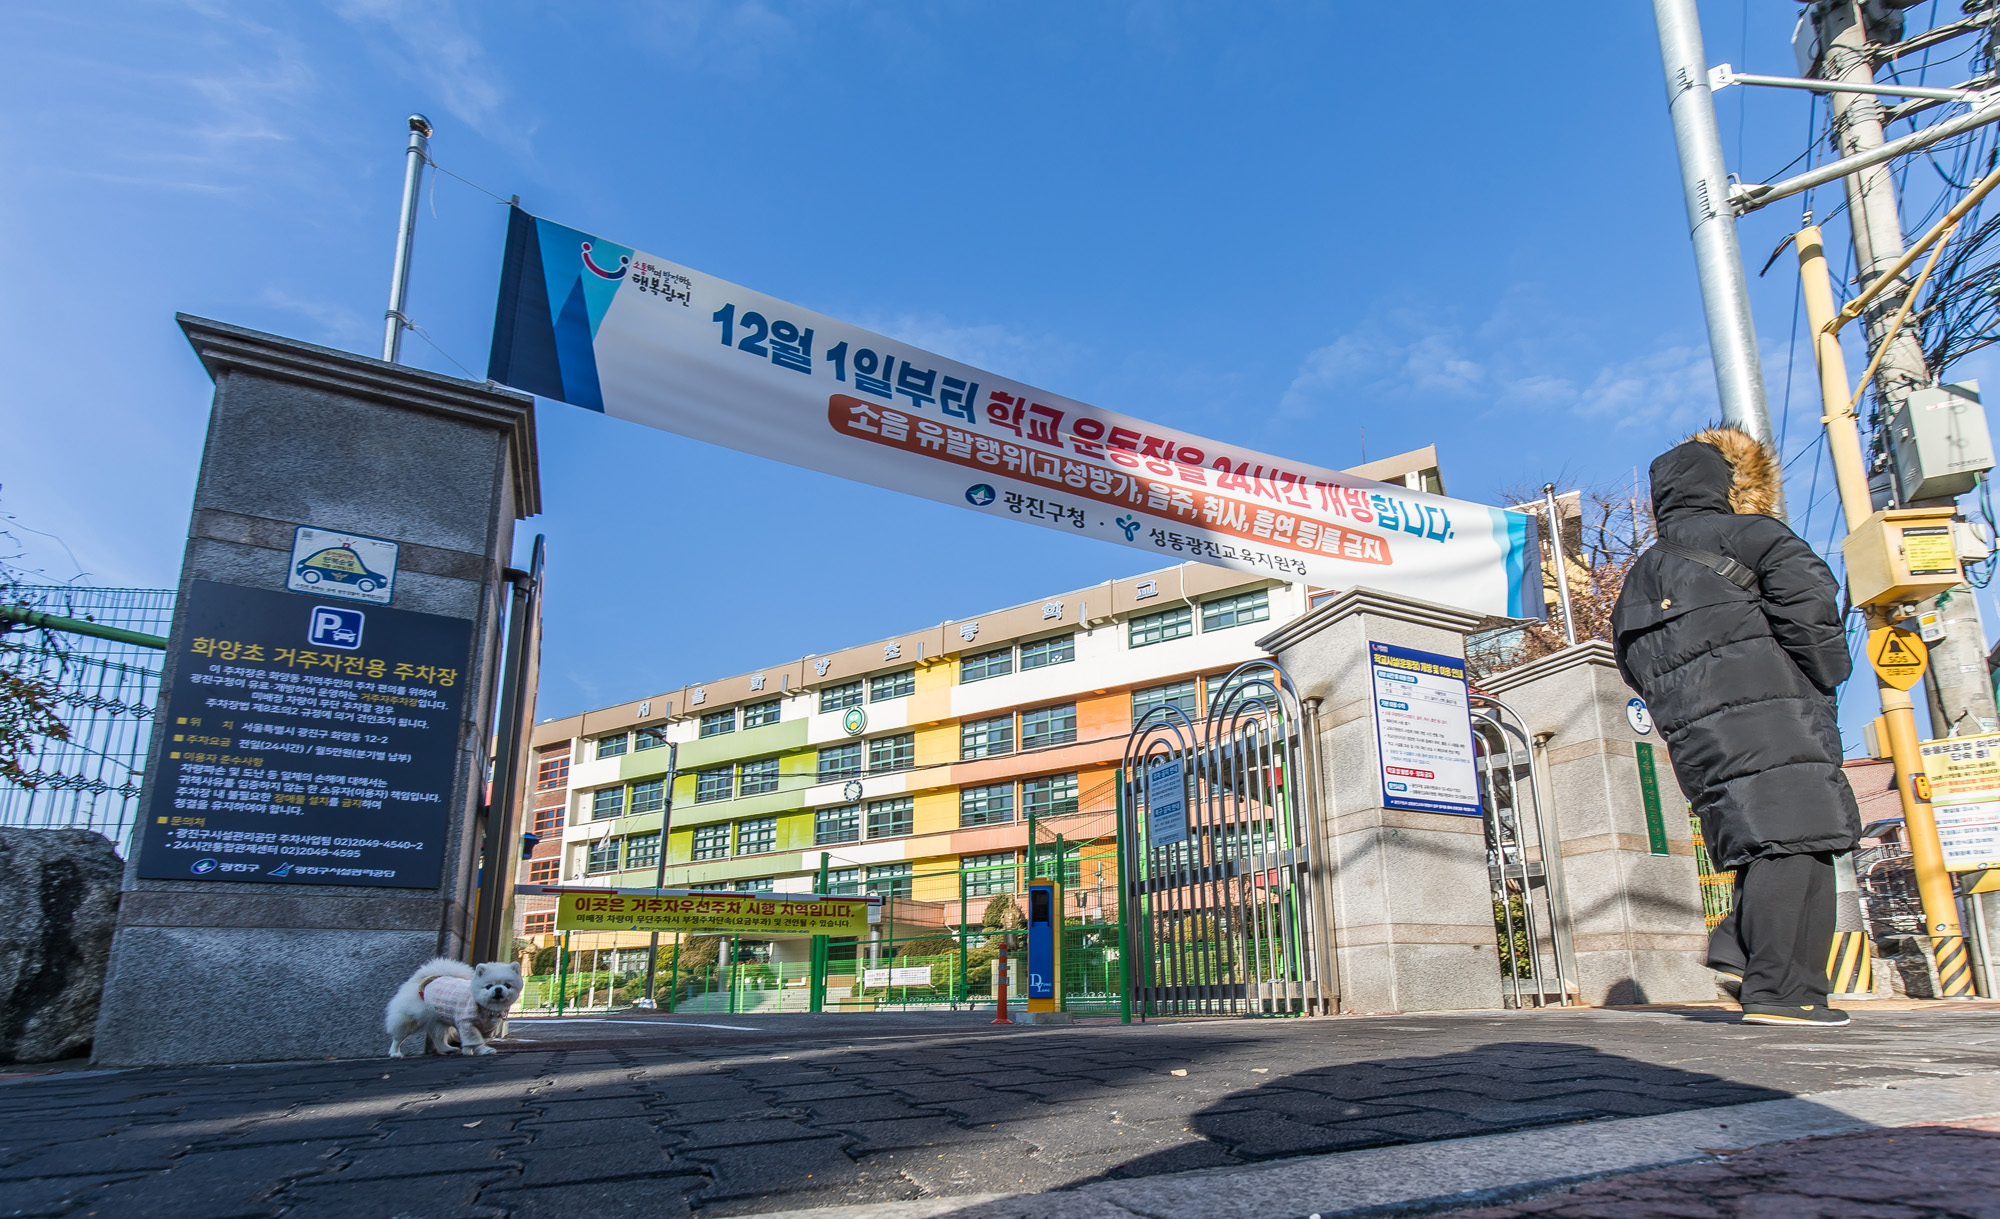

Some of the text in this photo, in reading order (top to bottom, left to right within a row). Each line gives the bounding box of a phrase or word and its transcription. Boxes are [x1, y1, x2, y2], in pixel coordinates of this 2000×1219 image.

[632, 273, 691, 307] 행복광진
[713, 303, 1456, 543] 12월 1일부터 학교 운동장을 24시간 개방합니다.
[847, 402, 1384, 562] 소음 유발행위(고성방가, 음주, 취사, 흡연 등)를 금지
[1003, 491, 1307, 575] 광진구청 성동광진교육지원청
[315, 612, 342, 639] P
[190, 636, 458, 687] 화양초 거주자전용 주차장
[1888, 655, 1909, 663] SOS
[190, 673, 246, 688] 광진구청이
[318, 687, 358, 700] 운영하는
[361, 693, 448, 710] 거주자주차장입니다.
[209, 664, 437, 698] 이 주차장은 화양동 지역주민의 주차 편의를 위하여
[205, 698, 250, 711] 주차장법
[300, 708, 333, 719] 규정에
[334, 711, 355, 722] 의거
[356, 713, 396, 726] 견인조치
[251, 692, 394, 715] 미배정 차량이 무단 주차할 경우
[1636, 712, 1643, 723] 9
[186, 734, 232, 747] 주차요금
[241, 722, 295, 736] 서울특별시
[297, 727, 329, 739] 광진구
[330, 731, 361, 742] 화양동
[364, 735, 389, 744] 12-2
[183, 751, 264, 767] 이용자 준수사항
[1950, 752, 1973, 761] 단속
[228, 766, 241, 777] 및
[241, 768, 265, 778] 도난
[267, 770, 279, 780] 등
[314, 773, 346, 785] 손해에
[347, 776, 388, 788] 대해서는
[175, 786, 212, 798] 주차장
[213, 789, 226, 799] 내
[227, 790, 272, 802] 불필요한
[390, 790, 442, 803] 책임입니다.
[269, 803, 304, 816] 합니다.
[170, 816, 206, 827] 문의처
[175, 828, 277, 843] 광진구시설관리공단
[218, 862, 260, 873] 광진구
[575, 897, 856, 918] 이곳은 거주자우선주차 시행 지역입니다.
[576, 914, 604, 923] 미배정
[606, 914, 634, 924] 차량이
[636, 915, 680, 924] 무단주차시
[682, 916, 771, 926] 부정주차단속(요금부과)
[774, 918, 782, 927] 및
[809, 919, 817, 928] 수
[819, 919, 852, 928] 있습니다.
